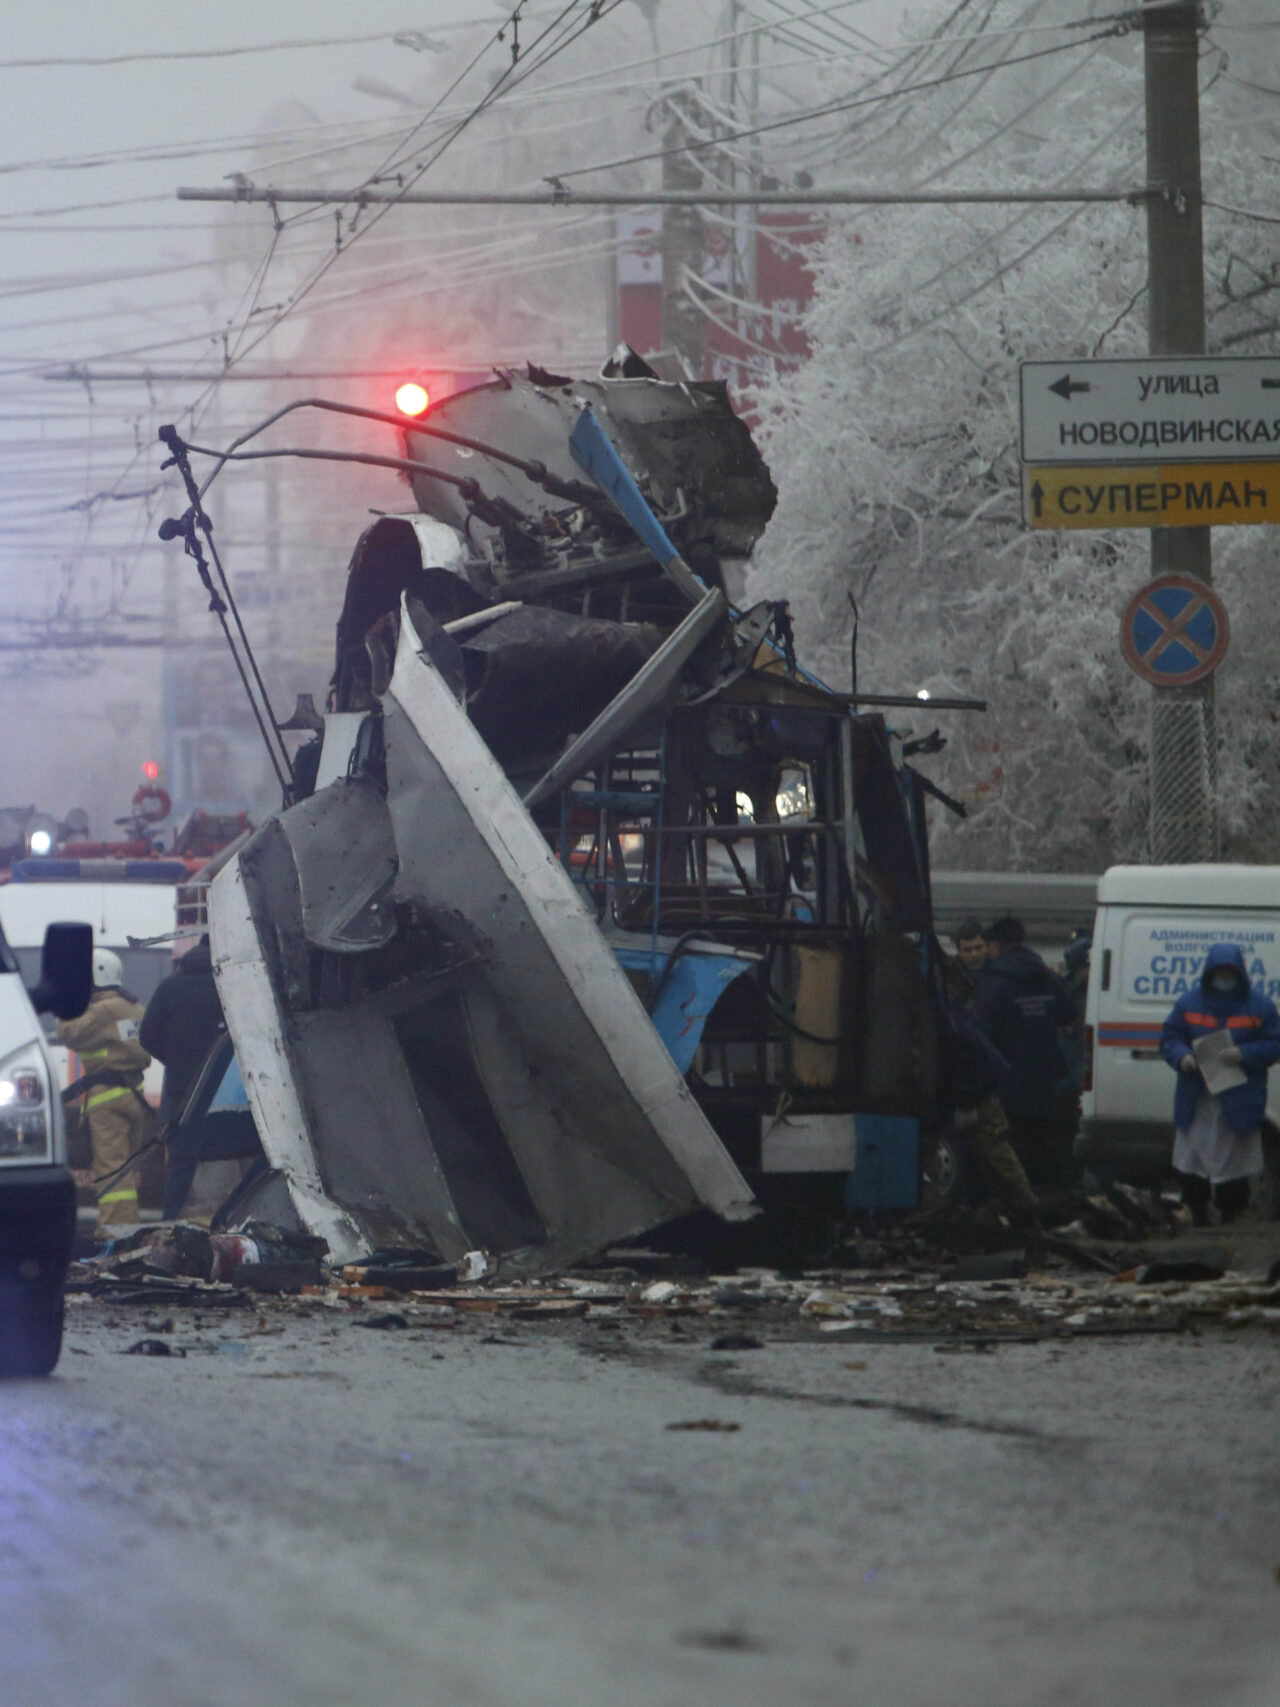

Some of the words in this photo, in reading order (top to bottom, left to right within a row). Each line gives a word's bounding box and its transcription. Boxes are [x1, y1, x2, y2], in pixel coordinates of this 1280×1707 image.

[1138, 374, 1220, 401] улица
[1057, 480, 1267, 514] СУПЕРМАН
[1150, 929, 1275, 942] АДМИНИСТРАЦИЯ
[1150, 955, 1266, 977] СЛУА
